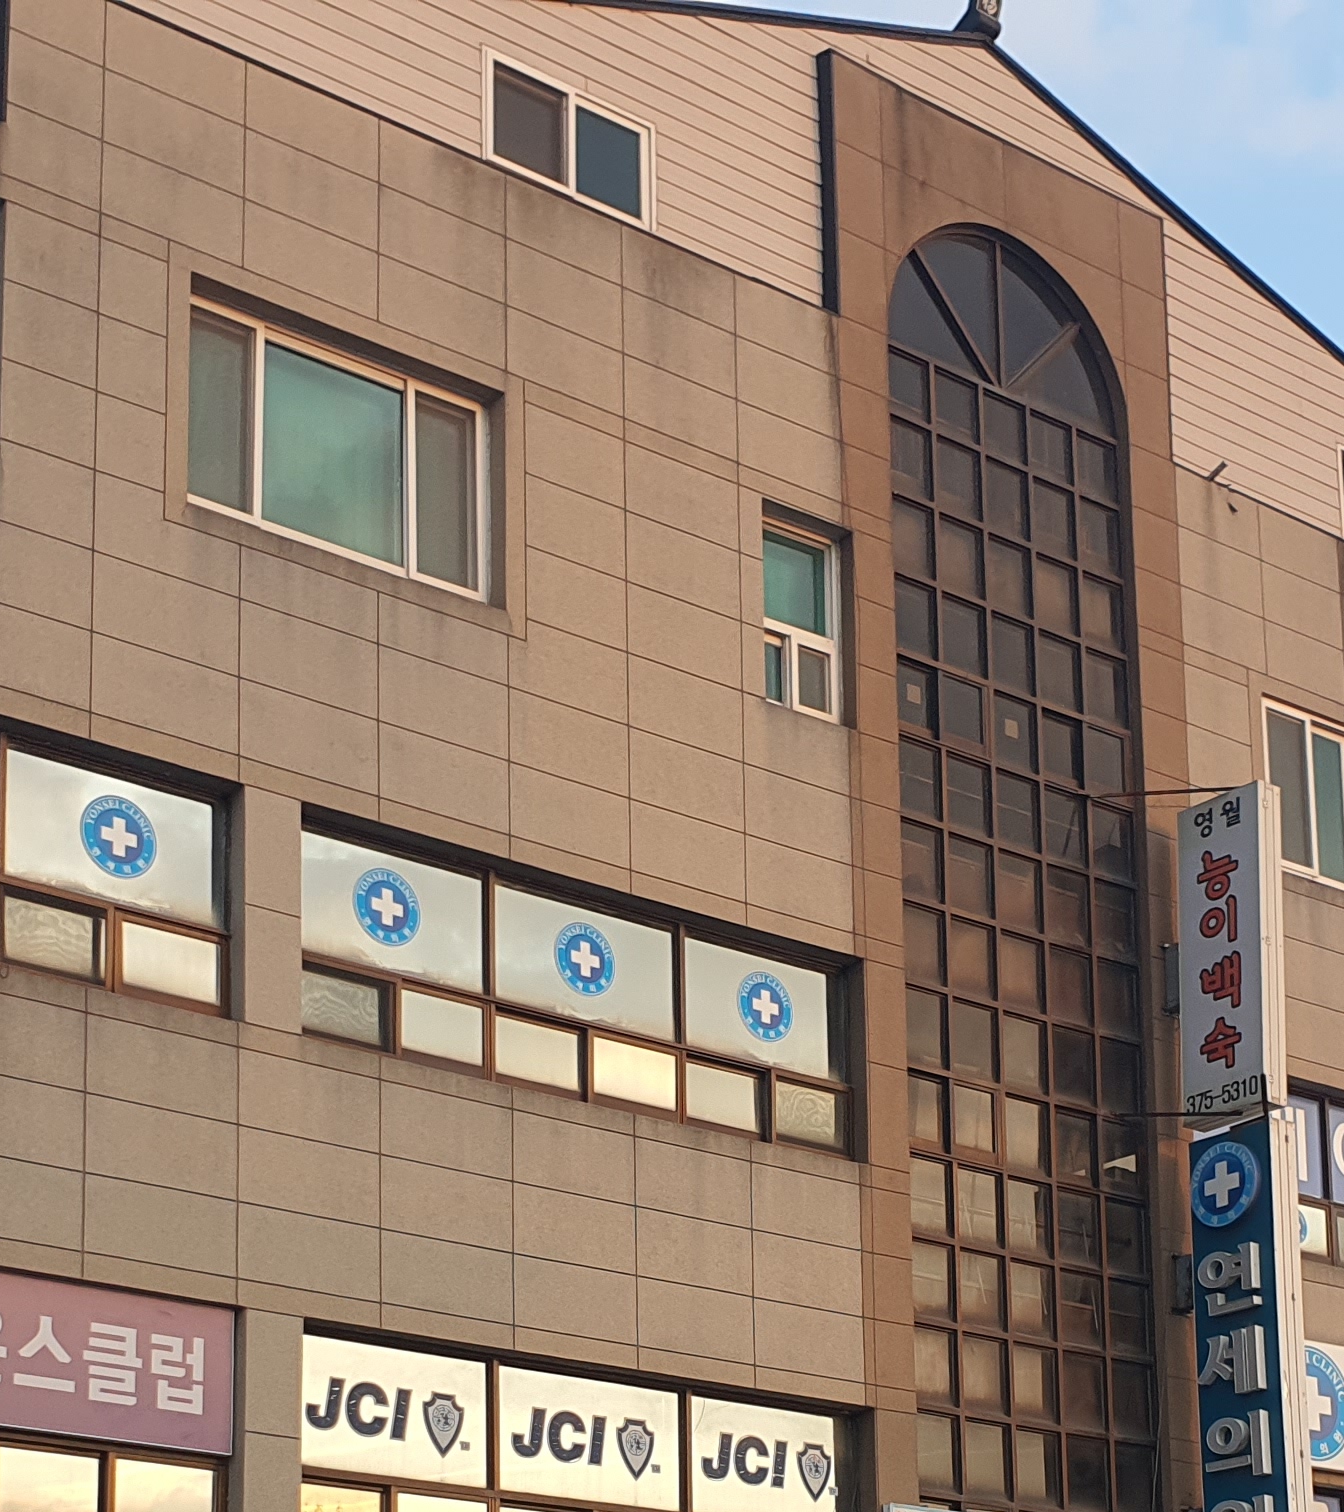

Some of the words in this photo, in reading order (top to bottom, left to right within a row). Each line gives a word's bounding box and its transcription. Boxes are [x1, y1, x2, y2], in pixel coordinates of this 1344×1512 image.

[86, 799, 120, 825] YONSEI
[121, 803, 152, 840] CLINIC
[1193, 796, 1242, 838] 영월
[356, 873, 387, 897] YONSEI
[388, 874, 416, 910] CLINIC
[1197, 850, 1243, 1069] 능이백숙
[1186, 1073, 1259, 1116] 375-5310
[305, 1375, 413, 1443] JCI
[510, 1406, 608, 1467] JCI
[700, 1431, 788, 1489] JCI
